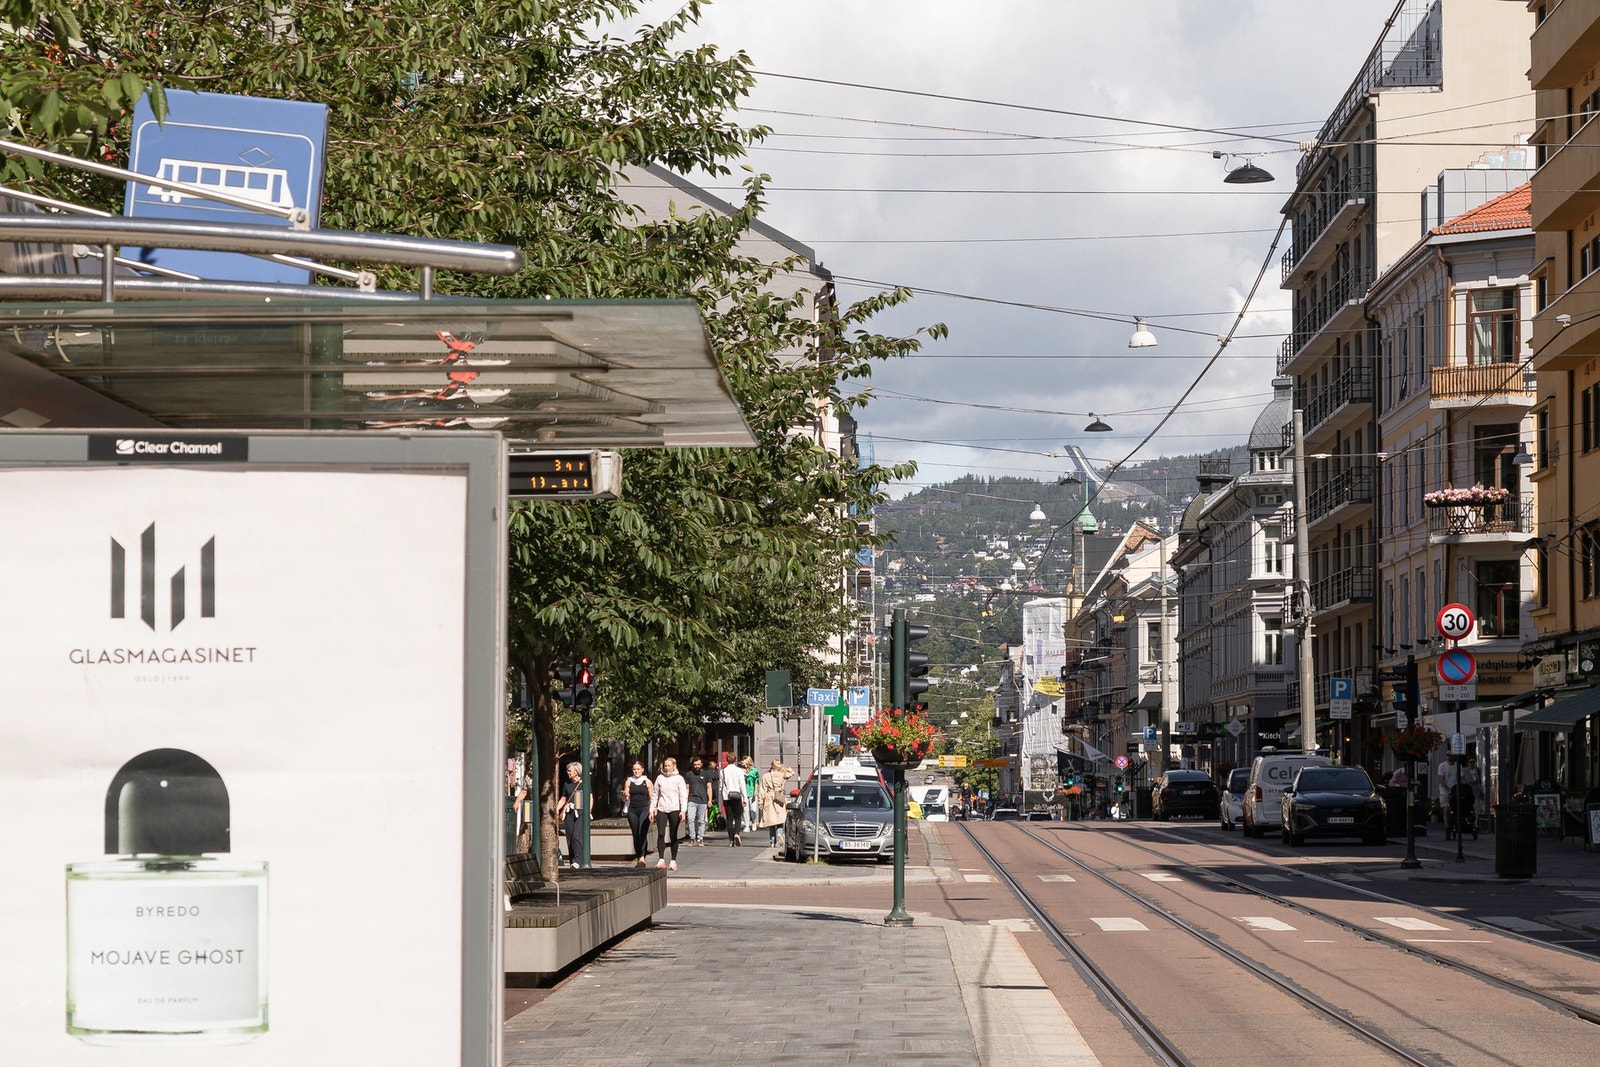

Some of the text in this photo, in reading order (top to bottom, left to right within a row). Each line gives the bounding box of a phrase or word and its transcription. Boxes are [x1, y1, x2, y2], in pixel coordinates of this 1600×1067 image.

[135, 441, 222, 454] Clear Channel
[1444, 613, 1468, 631] 30
[69, 647, 257, 664] GLASMAGASINET
[1335, 681, 1347, 697] P
[812, 691, 834, 702] Taxi
[1146, 728, 1153, 738] P
[136, 906, 200, 917] BYREDO
[91, 949, 245, 965] MOJAVE GHOST
